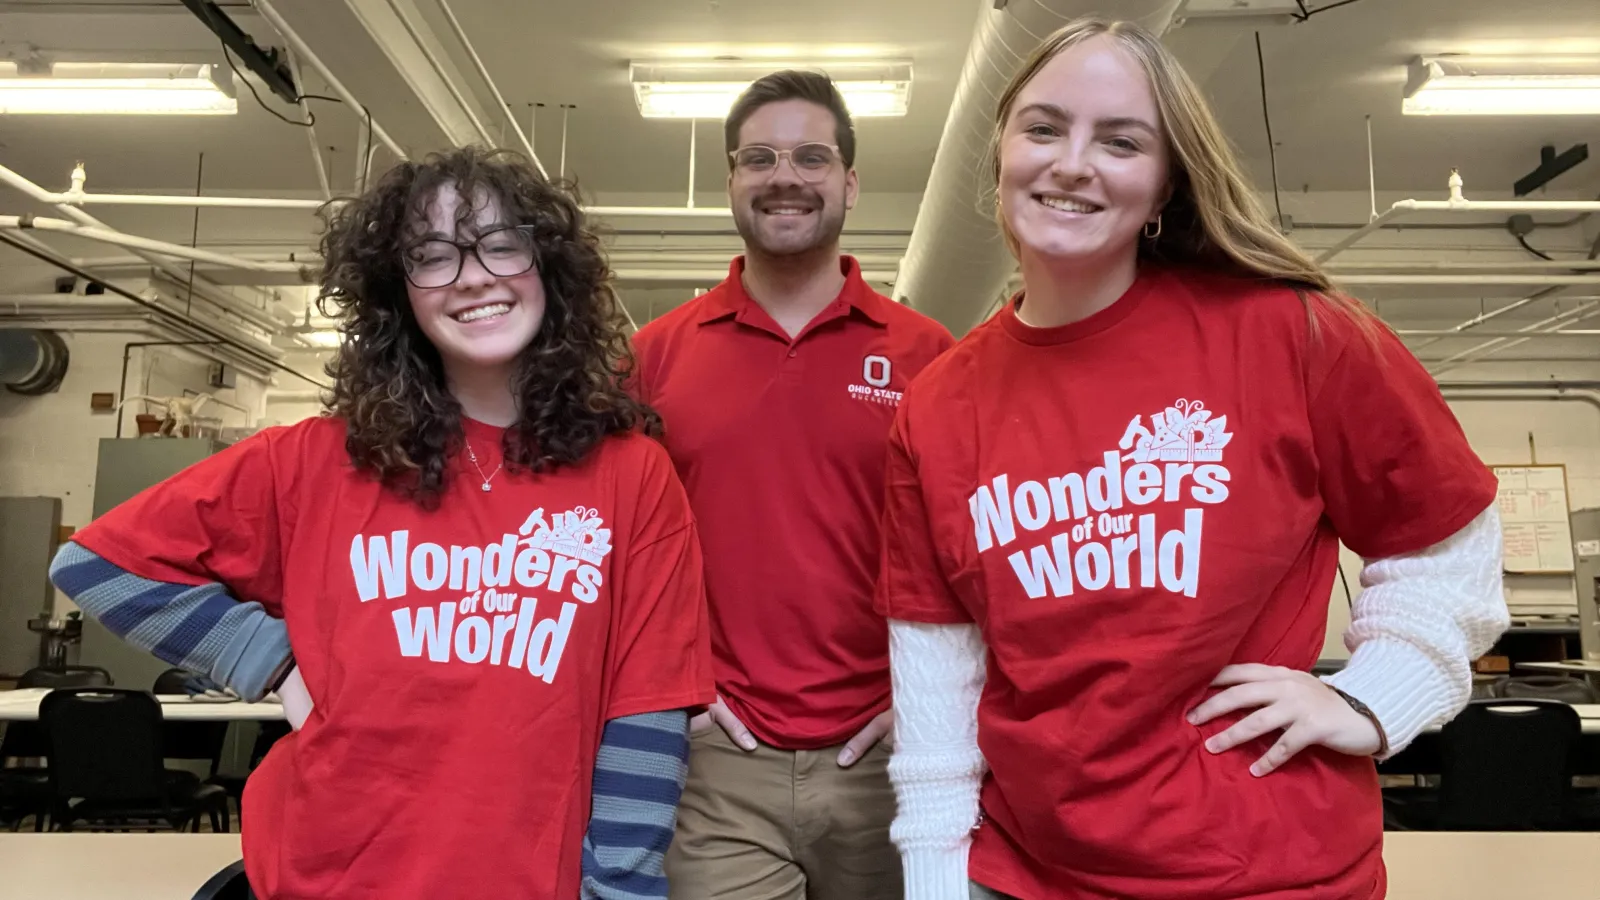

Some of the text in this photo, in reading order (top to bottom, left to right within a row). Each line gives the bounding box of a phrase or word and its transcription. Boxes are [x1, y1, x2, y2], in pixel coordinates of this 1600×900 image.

[848, 384, 903, 400] OHIO STATE
[863, 354, 892, 388] O
[968, 450, 1232, 554] Wonders
[1071, 512, 1134, 543] of Our
[350, 530, 604, 604] Wonders
[1007, 508, 1204, 599] World
[459, 588, 518, 614] of Our
[392, 597, 578, 685] World
